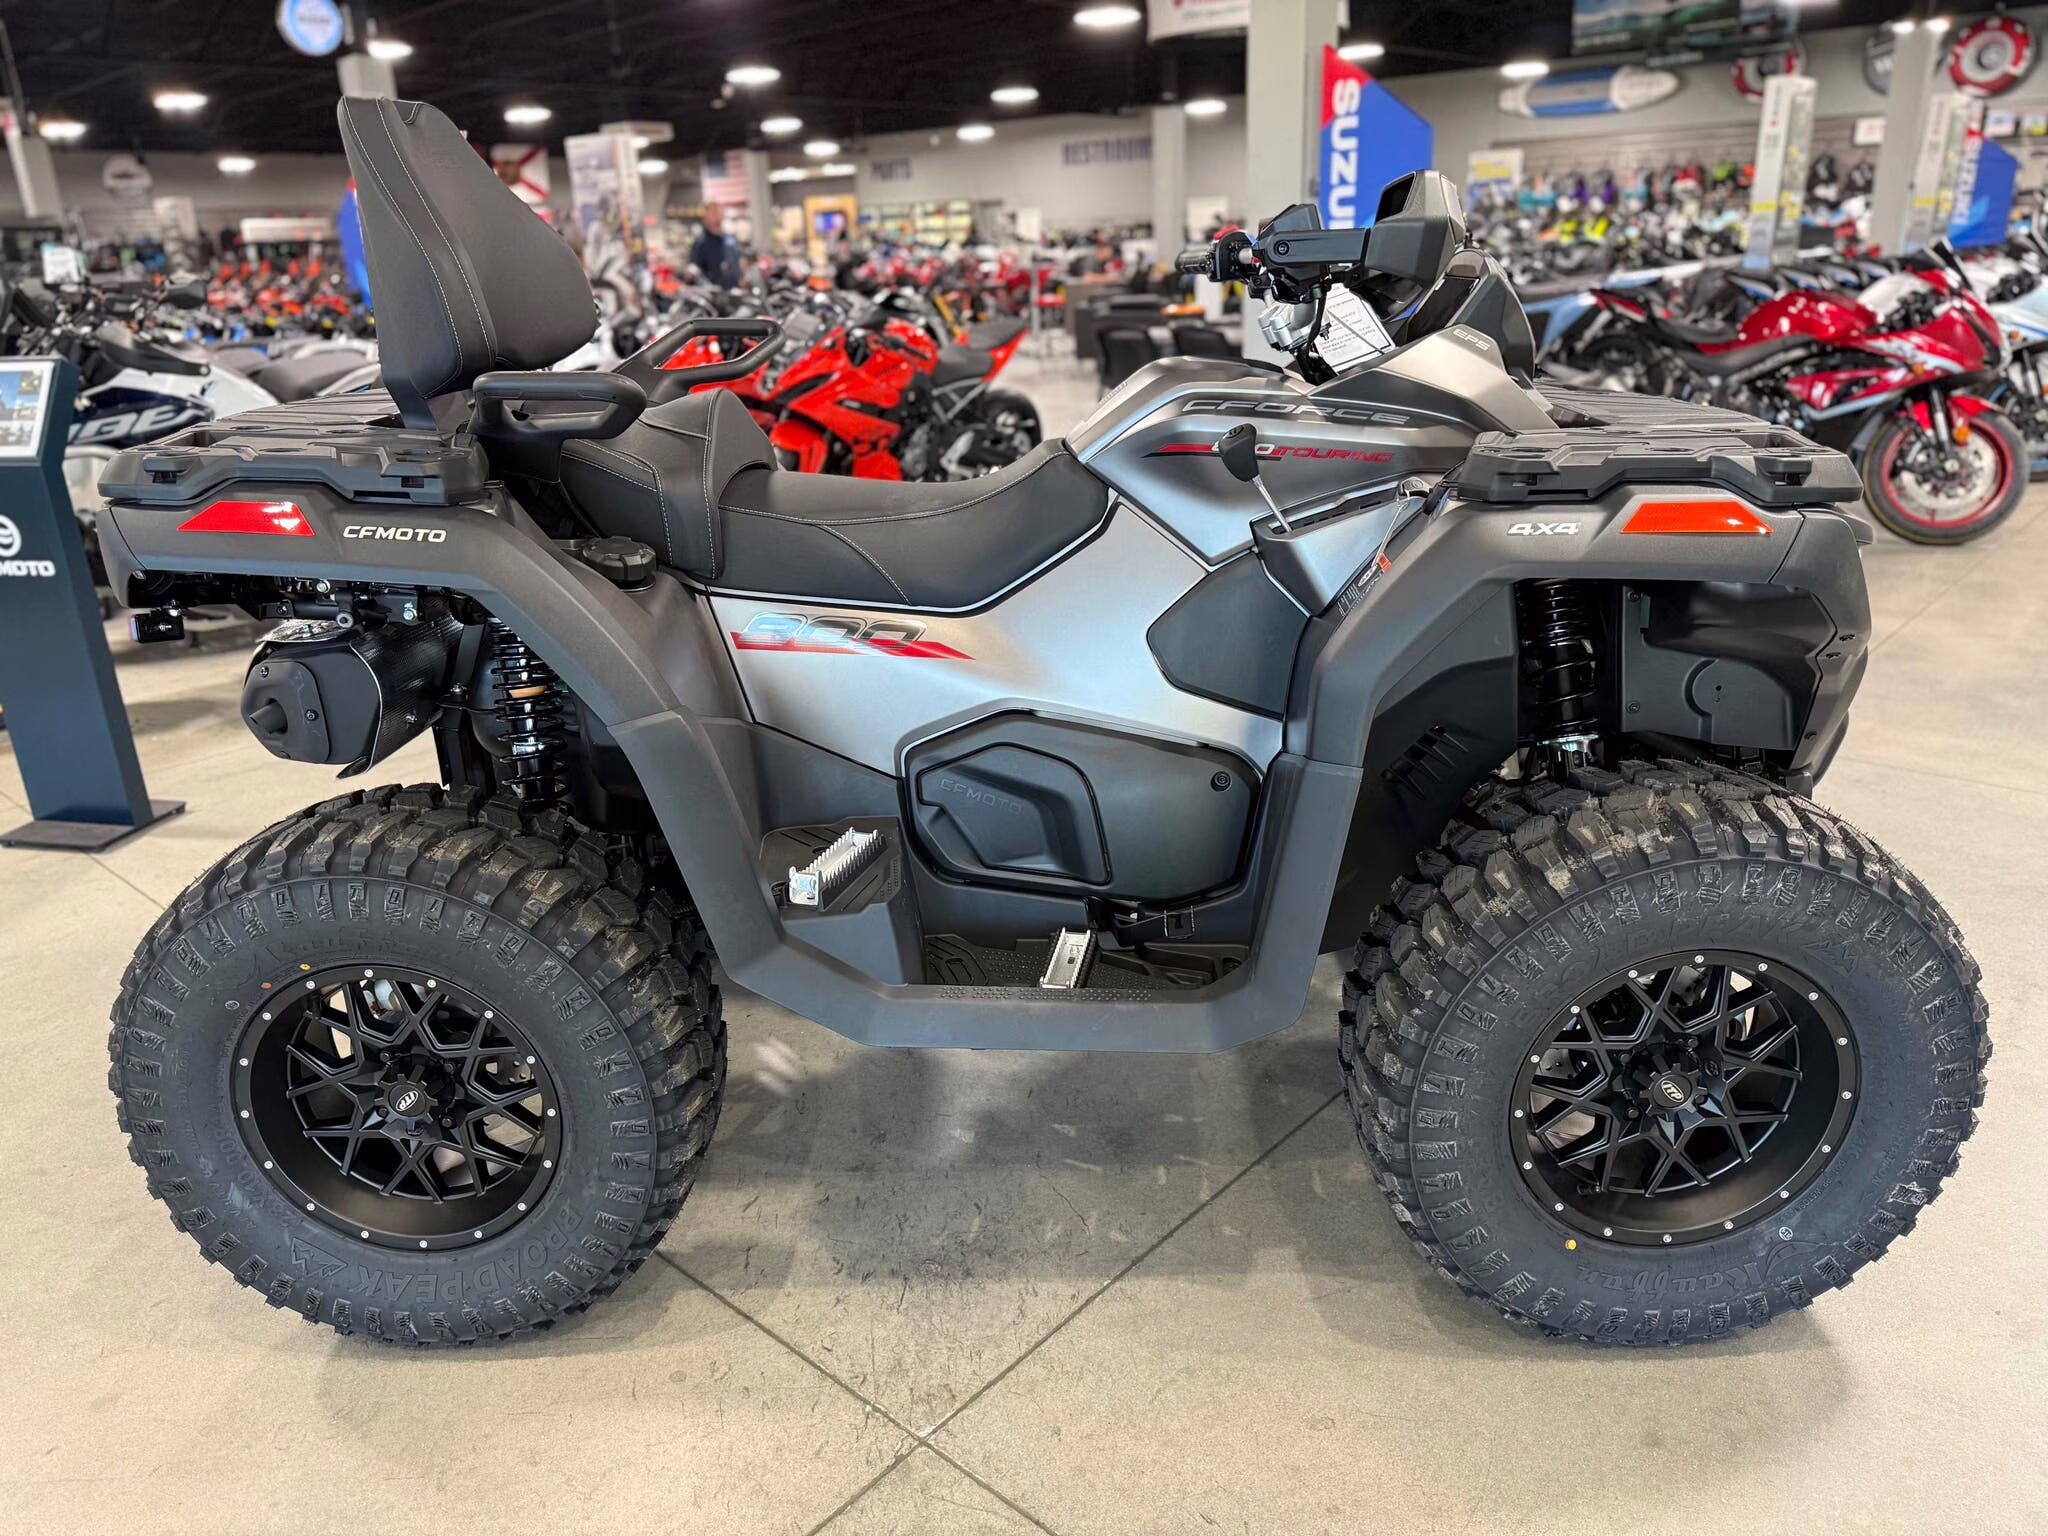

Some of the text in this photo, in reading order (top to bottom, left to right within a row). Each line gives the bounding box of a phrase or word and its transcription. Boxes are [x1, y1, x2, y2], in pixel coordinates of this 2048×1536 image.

[1453, 328, 1490, 351] EPS
[1182, 400, 1411, 425] CFORCE
[1278, 445, 1395, 464] TOURING
[343, 526, 447, 543] CFMOTO
[939, 778, 1023, 815] CFMOTO
[357, 1206, 583, 1304] BROAD PEAK
